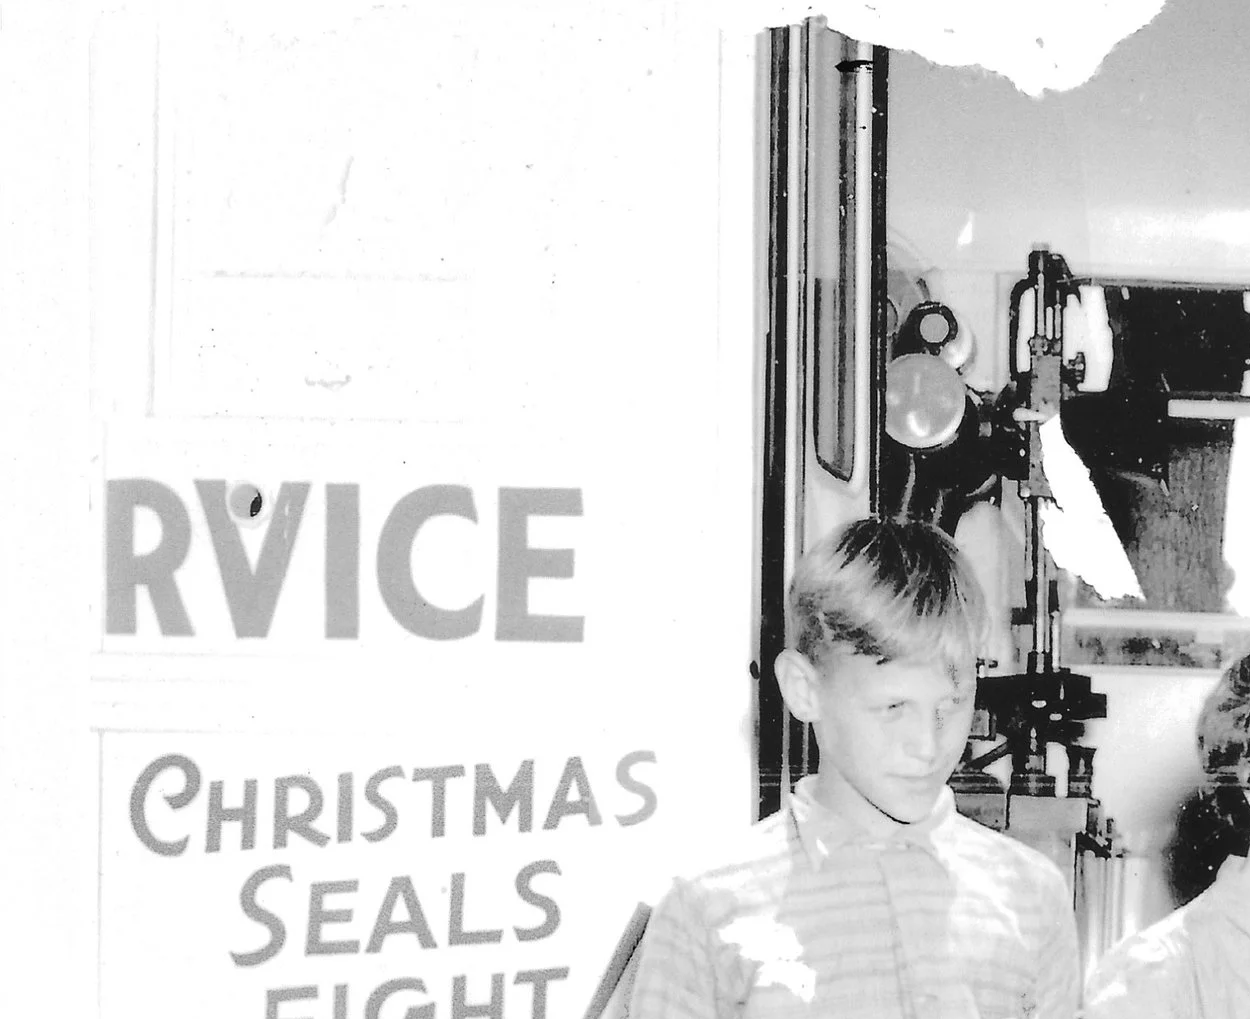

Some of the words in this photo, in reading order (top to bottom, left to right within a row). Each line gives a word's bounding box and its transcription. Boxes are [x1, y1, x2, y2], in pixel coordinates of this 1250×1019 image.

[104, 478, 586, 643] RVICE
[129, 750, 658, 858] CHRISTMAS
[229, 859, 564, 968] SEALS
